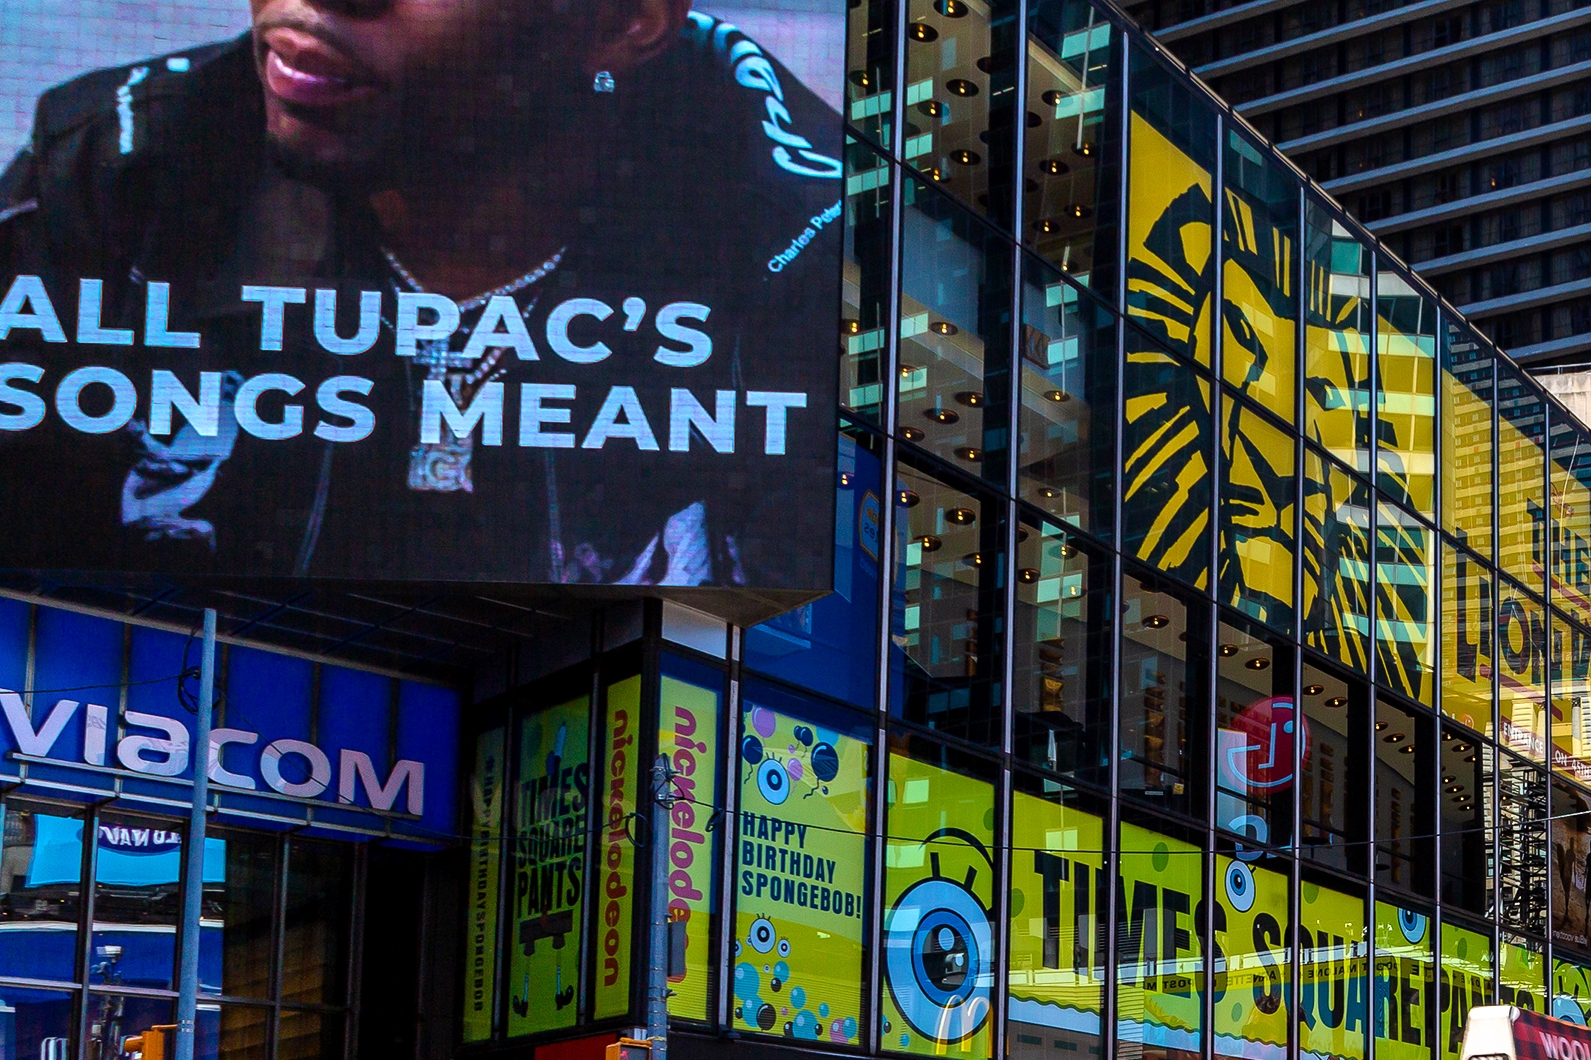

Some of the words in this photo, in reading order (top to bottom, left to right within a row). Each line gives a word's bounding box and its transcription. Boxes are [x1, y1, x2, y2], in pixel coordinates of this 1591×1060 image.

[767, 226, 817, 273] Charles
[0, 273, 201, 349] ALL
[0, 364, 377, 444] SONGS
[417, 381, 807, 458] MEANT
[1502, 722, 1544, 753] ENTRANCE
[1554, 750, 1567, 766] ON
[518, 762, 590, 828] TIMES
[517, 814, 587, 869] SQUARE
[603, 708, 634, 987] nickelodeon
[666, 705, 708, 983] nickelode
[742, 811, 807, 849] HAPPY
[742, 839, 836, 884] BIRTHDAY
[516, 856, 583, 919] PANTS
[741, 870, 862, 919] SPONGEBOB!
[1034, 850, 1228, 1004] TIMES
